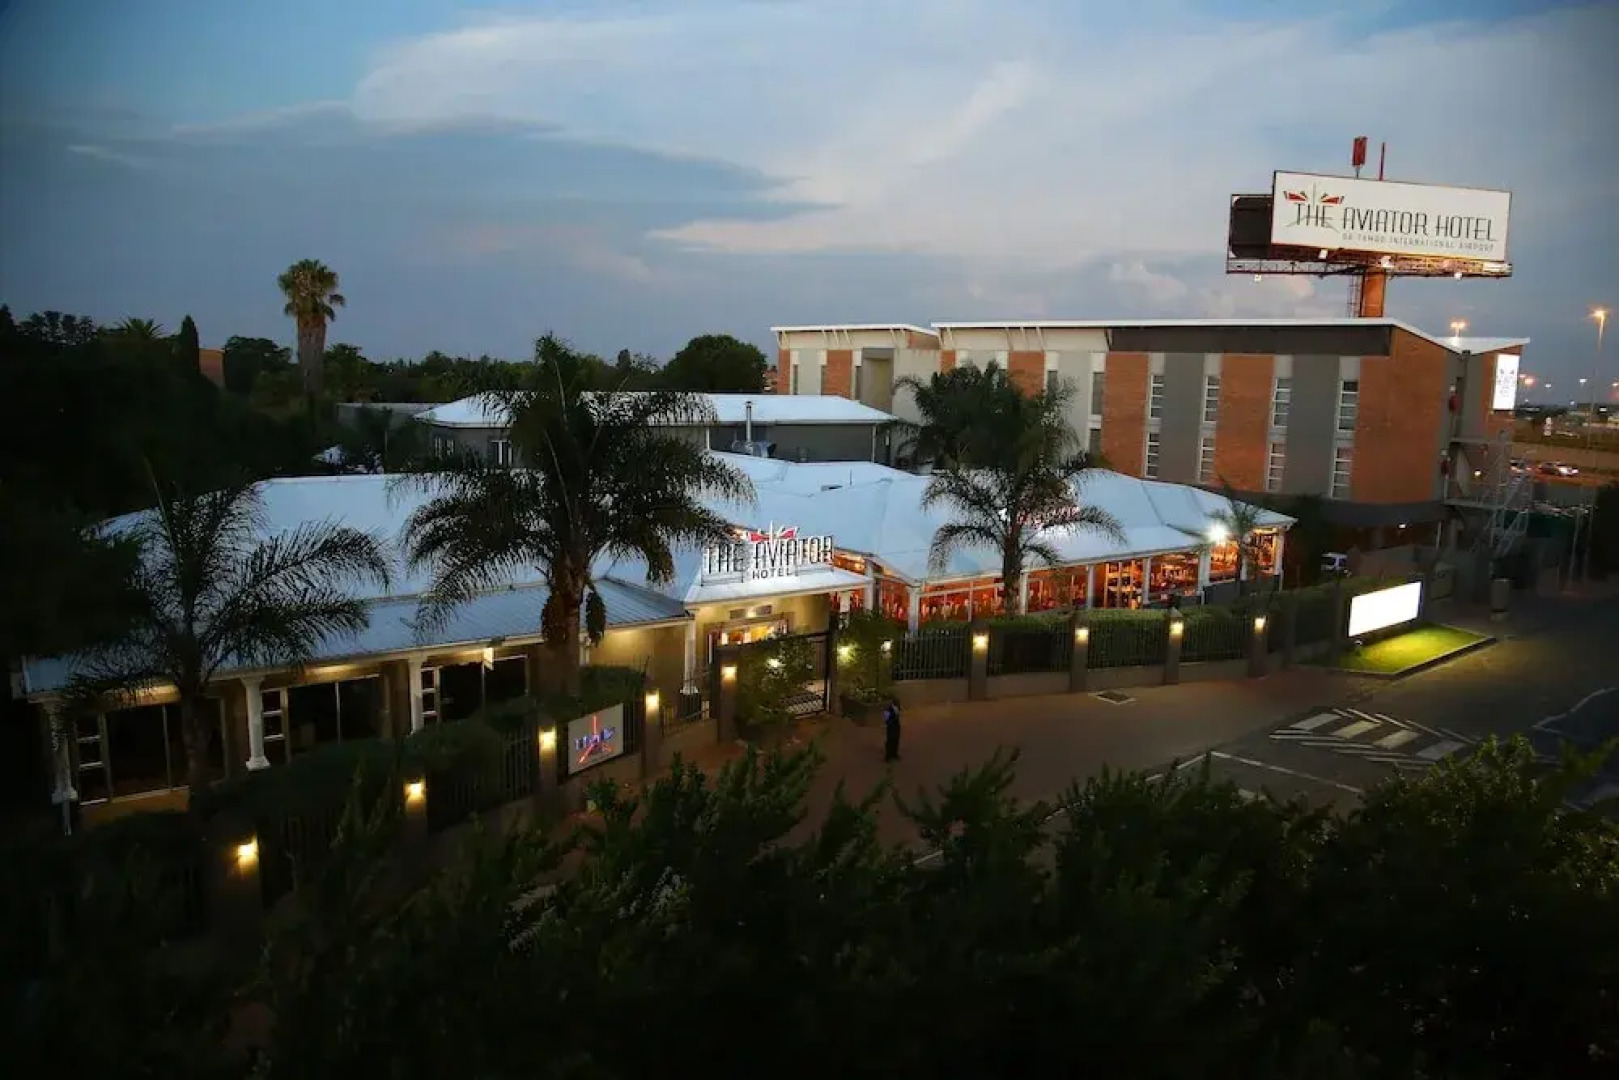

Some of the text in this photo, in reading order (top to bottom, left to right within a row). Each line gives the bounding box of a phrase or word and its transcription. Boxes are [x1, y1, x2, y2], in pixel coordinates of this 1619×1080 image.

[1294, 202, 1498, 242] THE AVIATOR HOTEL
[1390, 237, 1454, 249] INTERNATIONAL
[703, 535, 834, 574] THE AVIATOR
[752, 566, 792, 579] HOTEL
